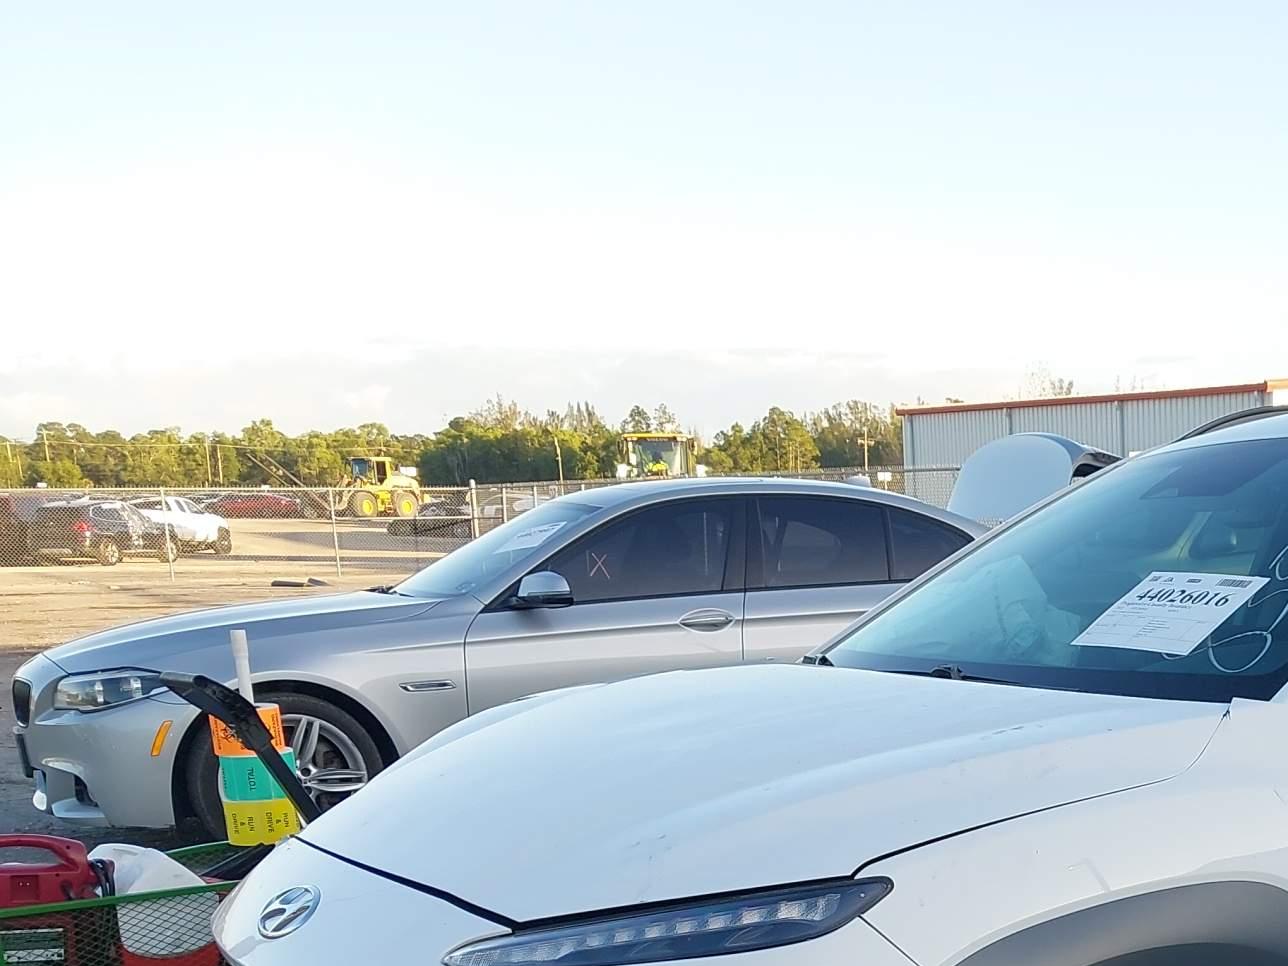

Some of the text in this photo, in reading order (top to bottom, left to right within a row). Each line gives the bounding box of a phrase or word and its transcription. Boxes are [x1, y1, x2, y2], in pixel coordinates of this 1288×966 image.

[1136, 587, 1234, 608] 44026016
[248, 767, 257, 791] TOTAL
[231, 812, 240, 835] DRIVE
[247, 816, 256, 833] RUN
[265, 811, 275, 833] DRIVE
